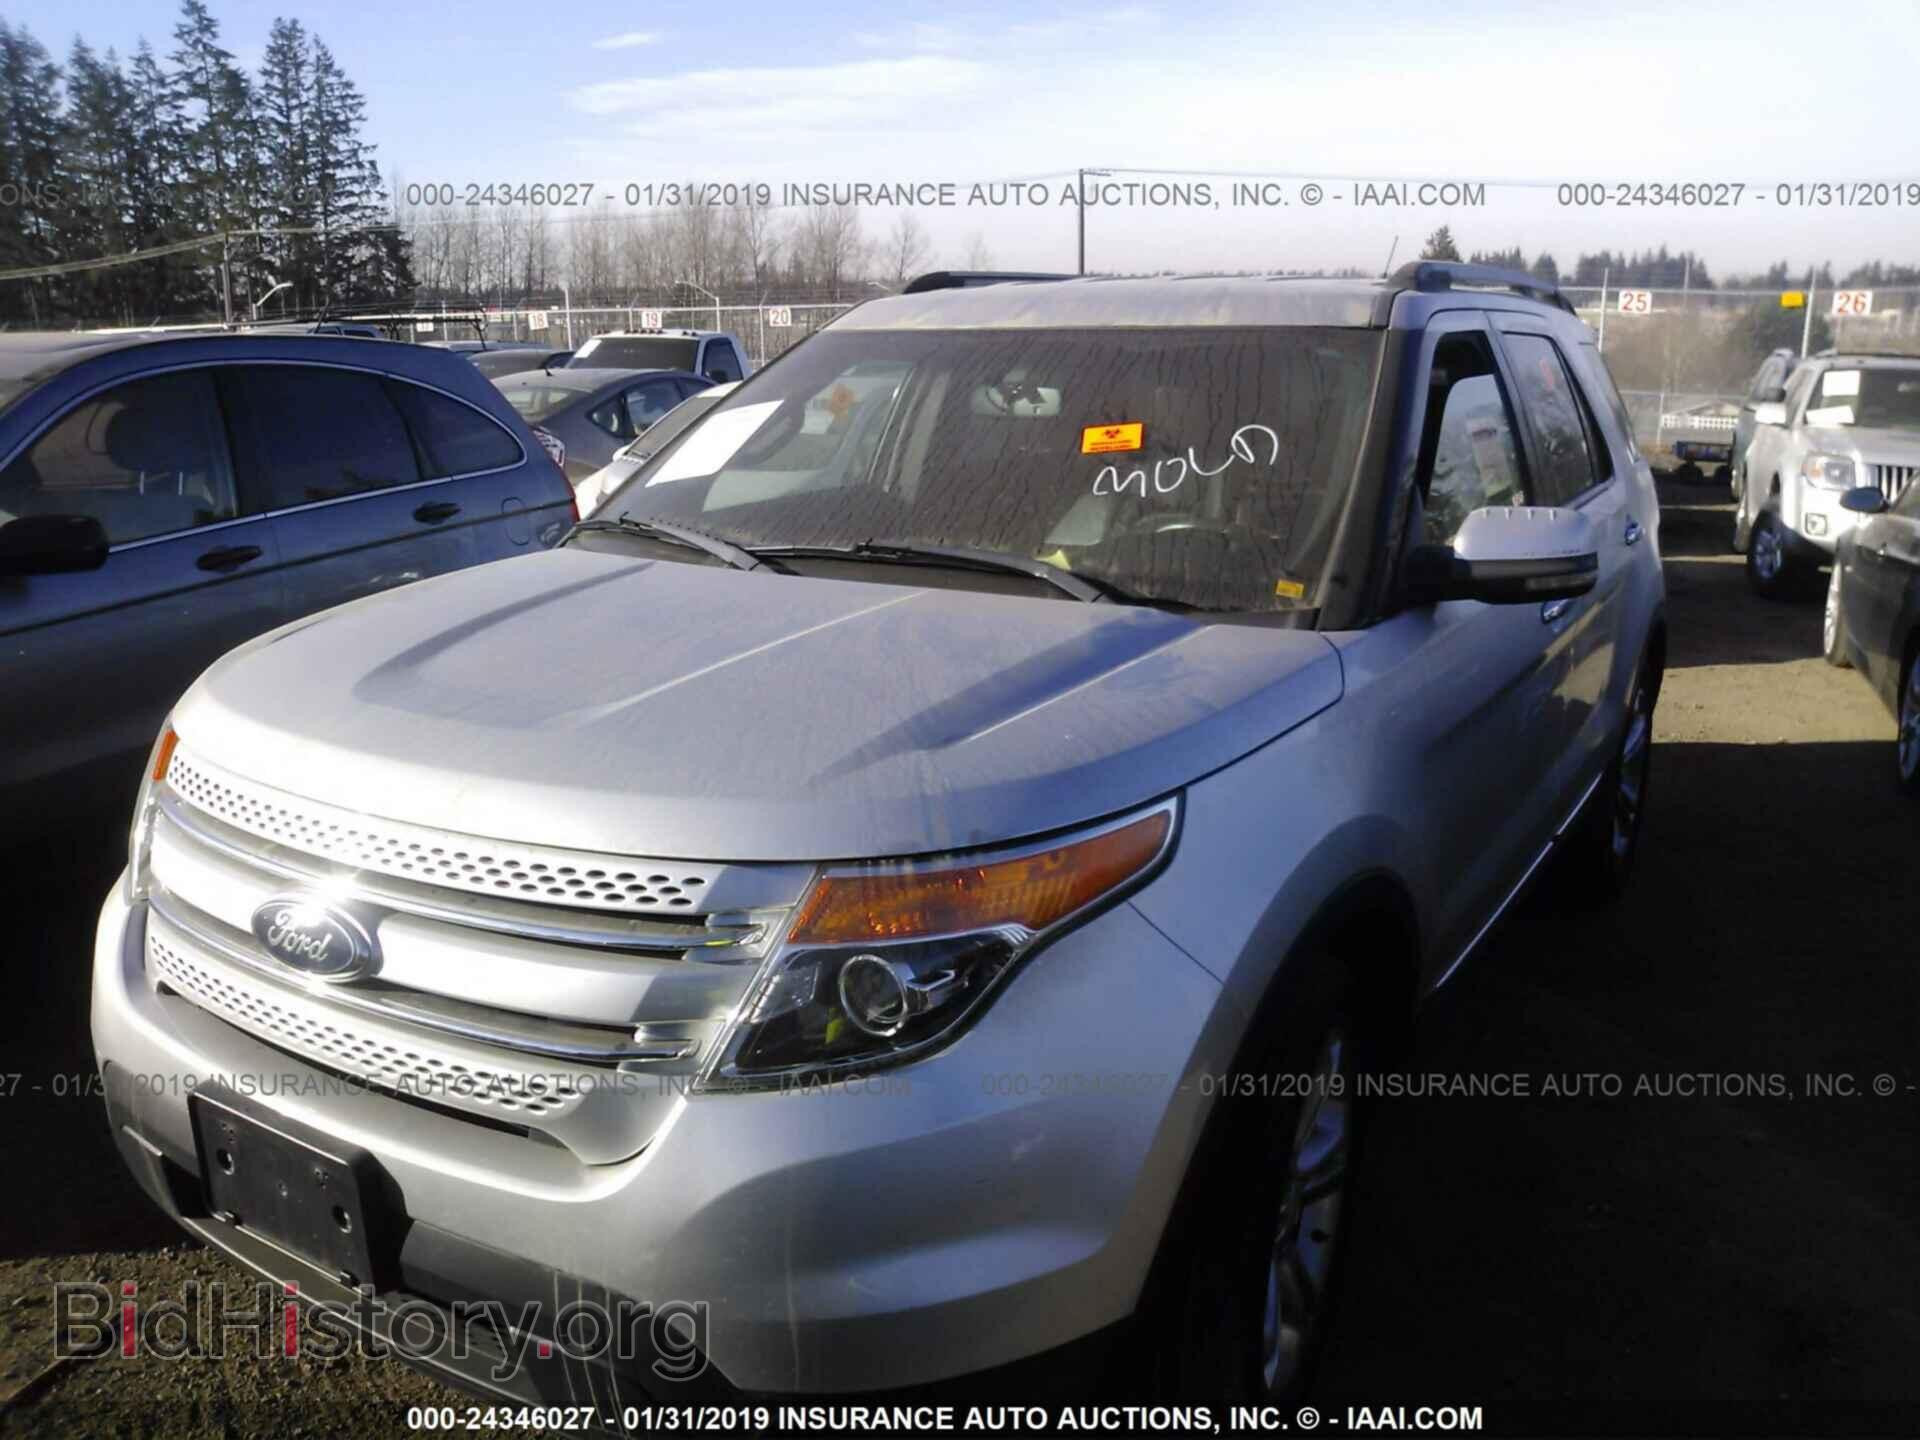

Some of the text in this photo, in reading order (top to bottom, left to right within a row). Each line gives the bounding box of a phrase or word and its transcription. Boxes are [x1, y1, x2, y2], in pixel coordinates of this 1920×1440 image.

[1622, 292, 1648, 313] 25
[1838, 293, 1866, 315] 26
[771, 309, 789, 326] 20
[267, 908, 332, 962] Ford
